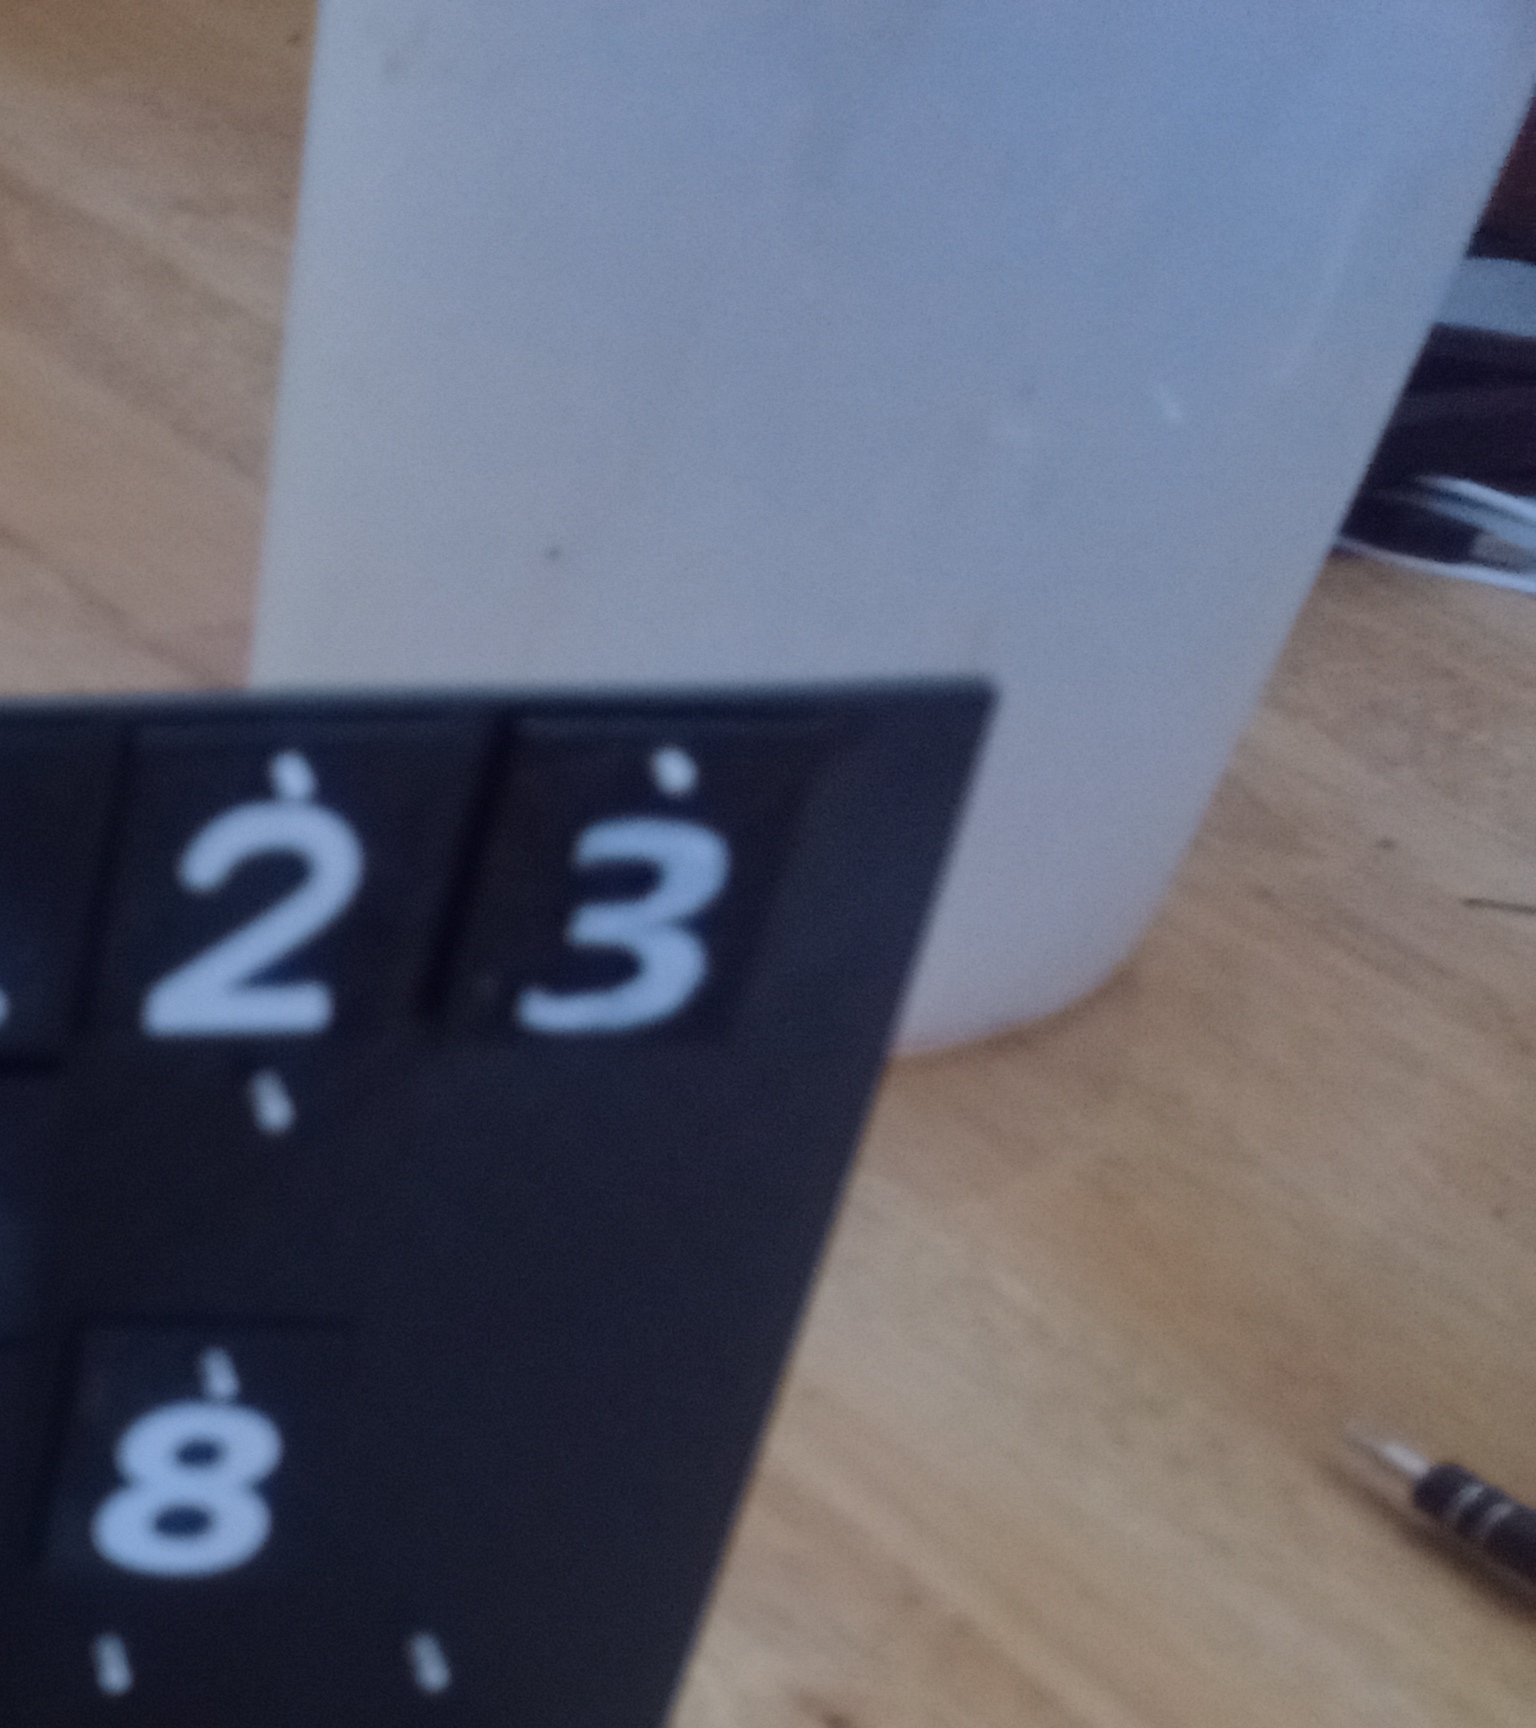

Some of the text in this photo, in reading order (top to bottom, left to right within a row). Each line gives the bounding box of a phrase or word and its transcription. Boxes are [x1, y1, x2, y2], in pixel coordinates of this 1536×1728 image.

[142, 800, 365, 1036] 2
[518, 818, 730, 1034] 3
[92, 1402, 282, 1577] 8
